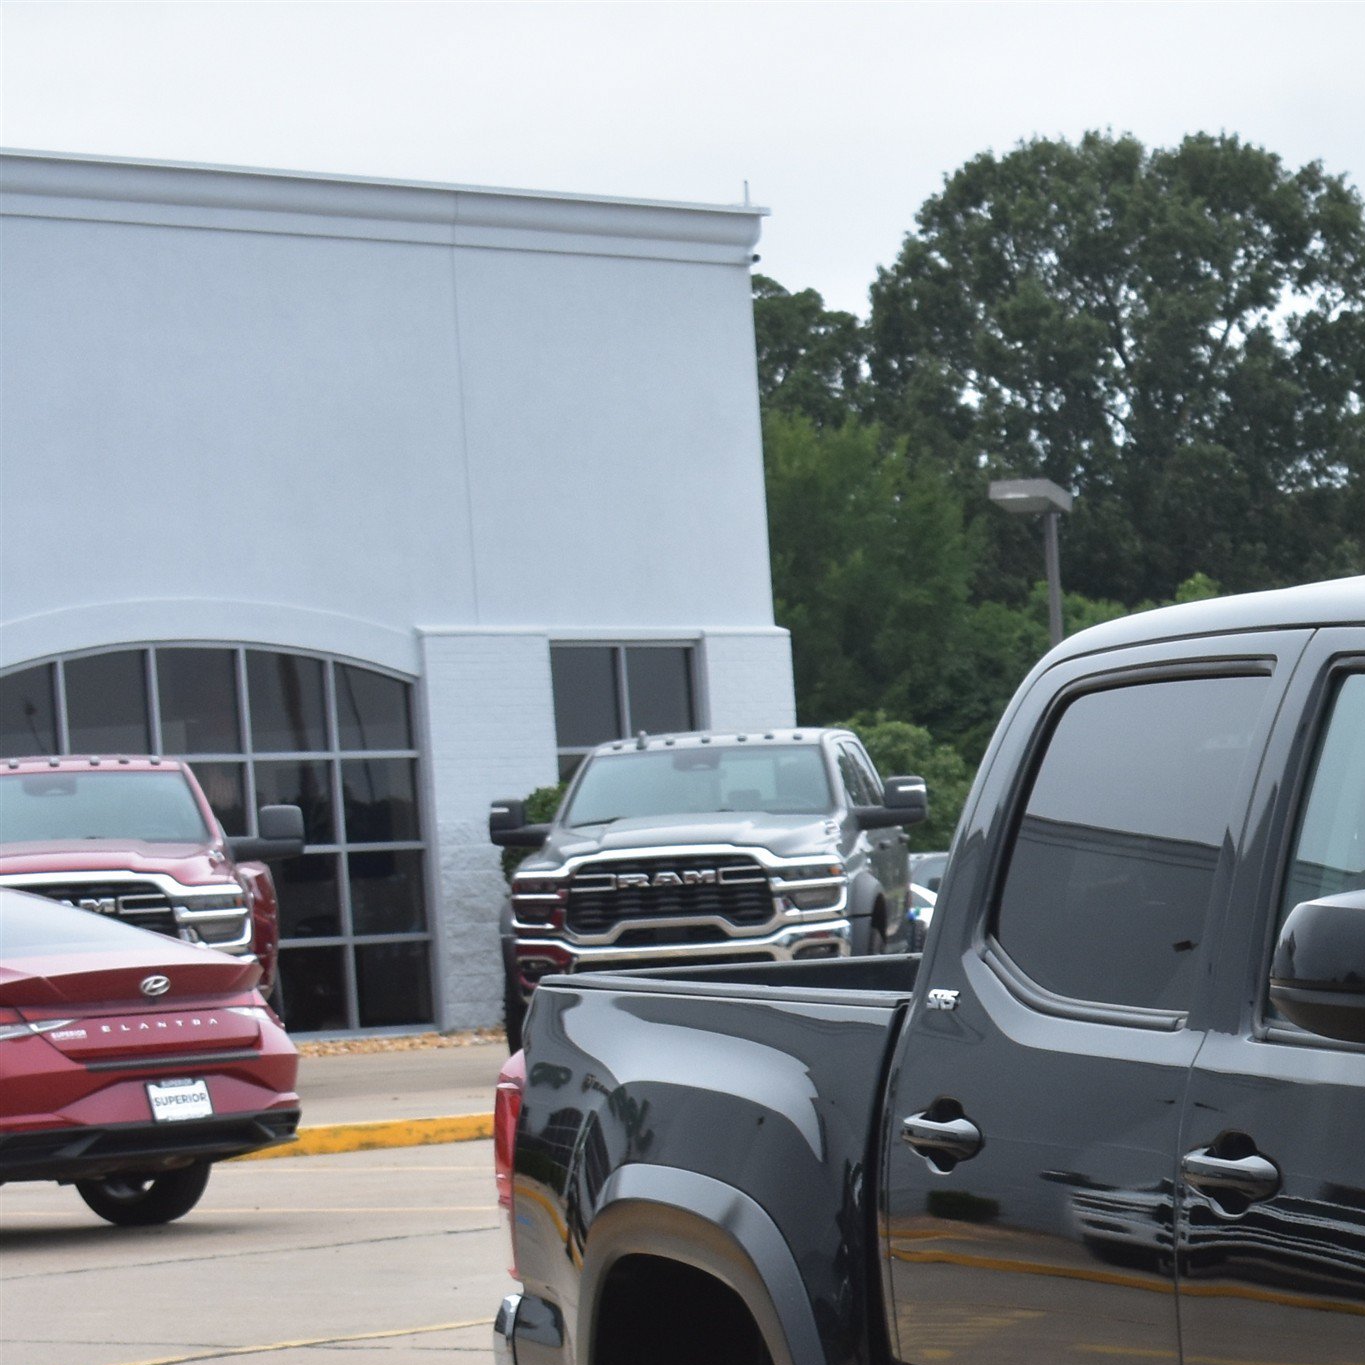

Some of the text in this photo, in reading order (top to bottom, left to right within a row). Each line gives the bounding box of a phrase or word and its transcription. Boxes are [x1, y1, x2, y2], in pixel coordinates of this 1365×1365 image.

[616, 869, 716, 889] RAM
[926, 988, 960, 1010] SR5
[102, 1019, 218, 1032] ELANTRA
[154, 1092, 207, 1107] SUPERIOR
